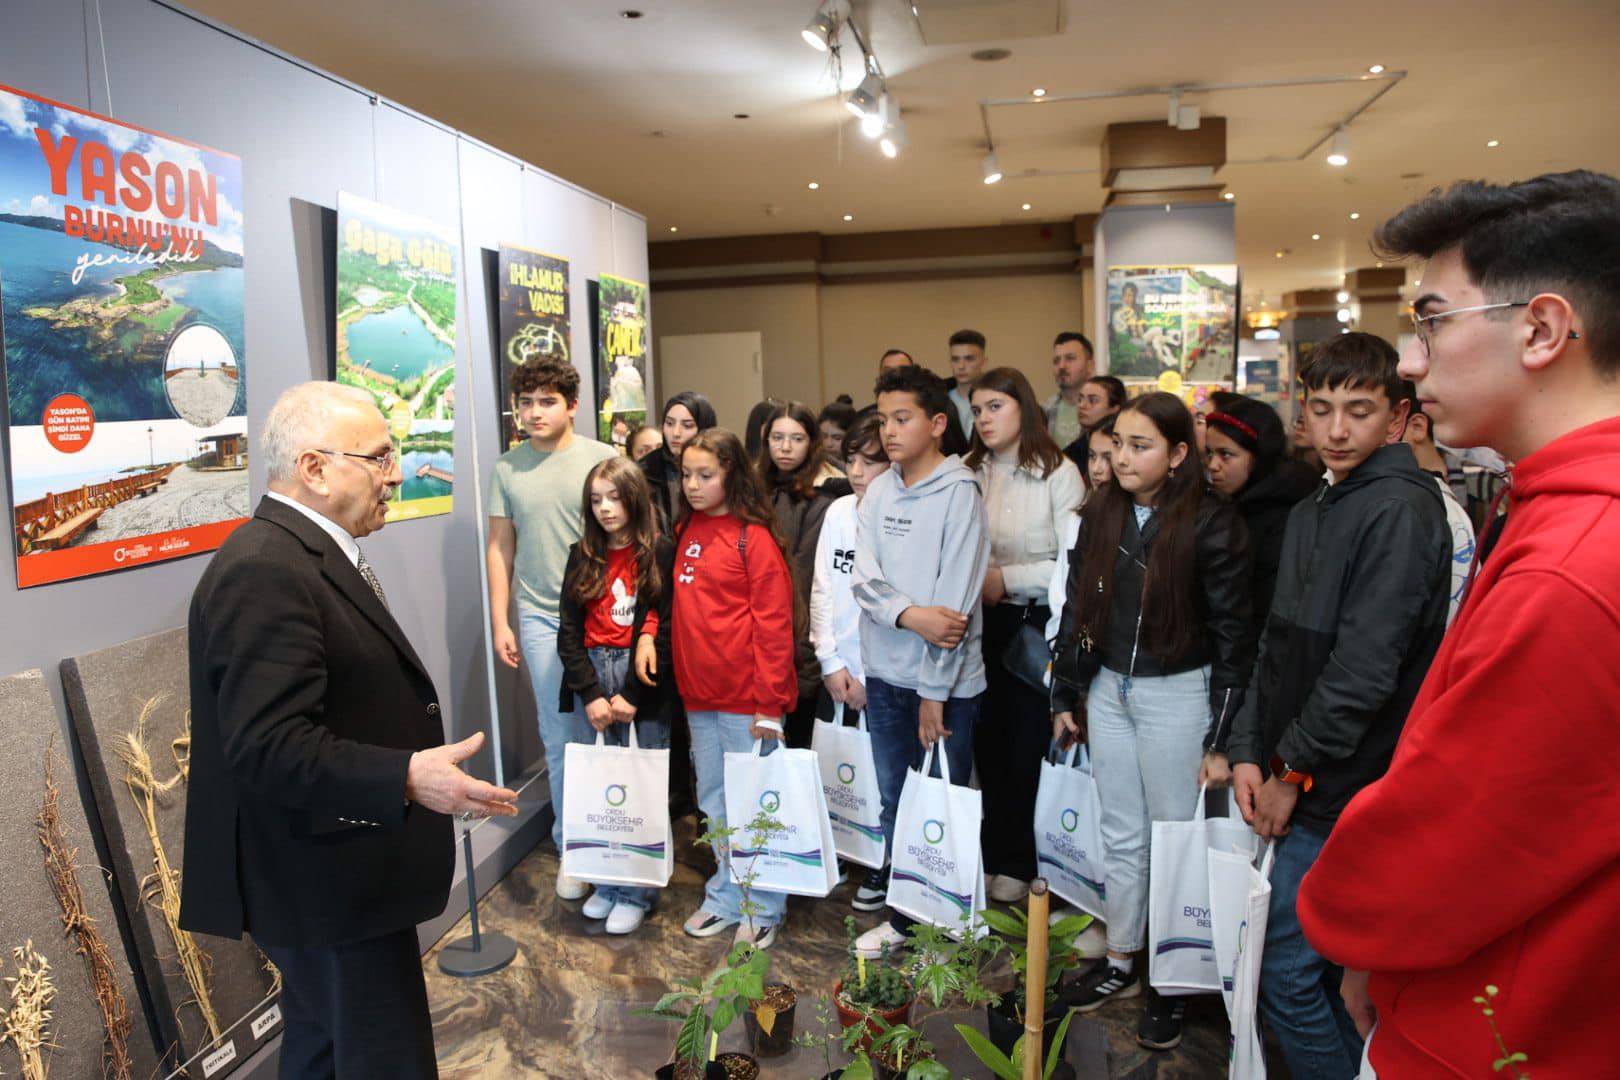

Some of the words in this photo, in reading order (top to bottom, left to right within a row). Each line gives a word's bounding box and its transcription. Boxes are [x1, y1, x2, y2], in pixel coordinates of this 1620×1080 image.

[34, 127, 218, 226] YASON
[63, 204, 205, 257] BURNU'NU
[71, 240, 201, 285] yeniledik
[48, 416, 65, 425] GÜN
[50, 408, 88, 416] YASON'DA
[256, 1012, 276, 1032] ARPA
